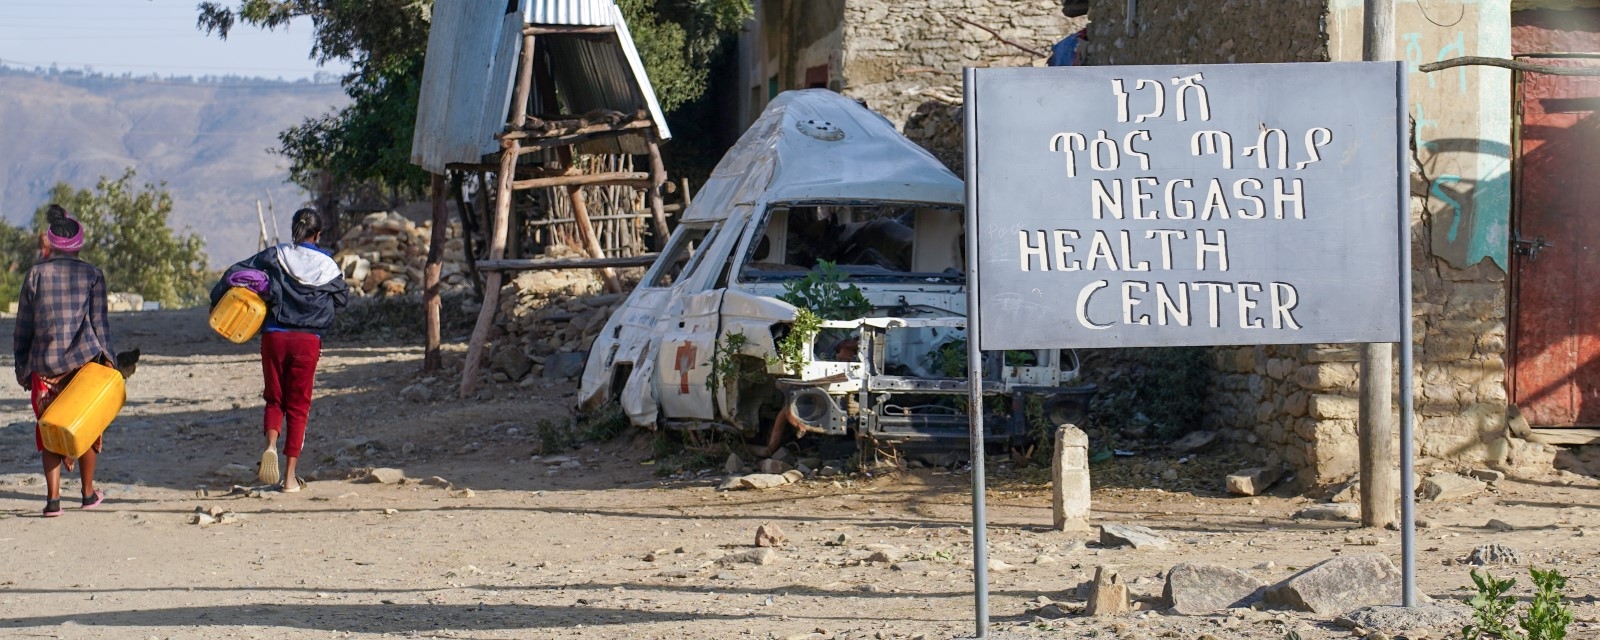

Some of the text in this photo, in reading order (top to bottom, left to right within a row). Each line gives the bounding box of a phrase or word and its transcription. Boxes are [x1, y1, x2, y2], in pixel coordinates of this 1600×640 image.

[1190, 127, 1333, 171] ጣብያ
[1091, 178, 1306, 221] NEGASH
[1018, 229, 1229, 272] HEALTH
[1075, 280, 1303, 331] CENTER
